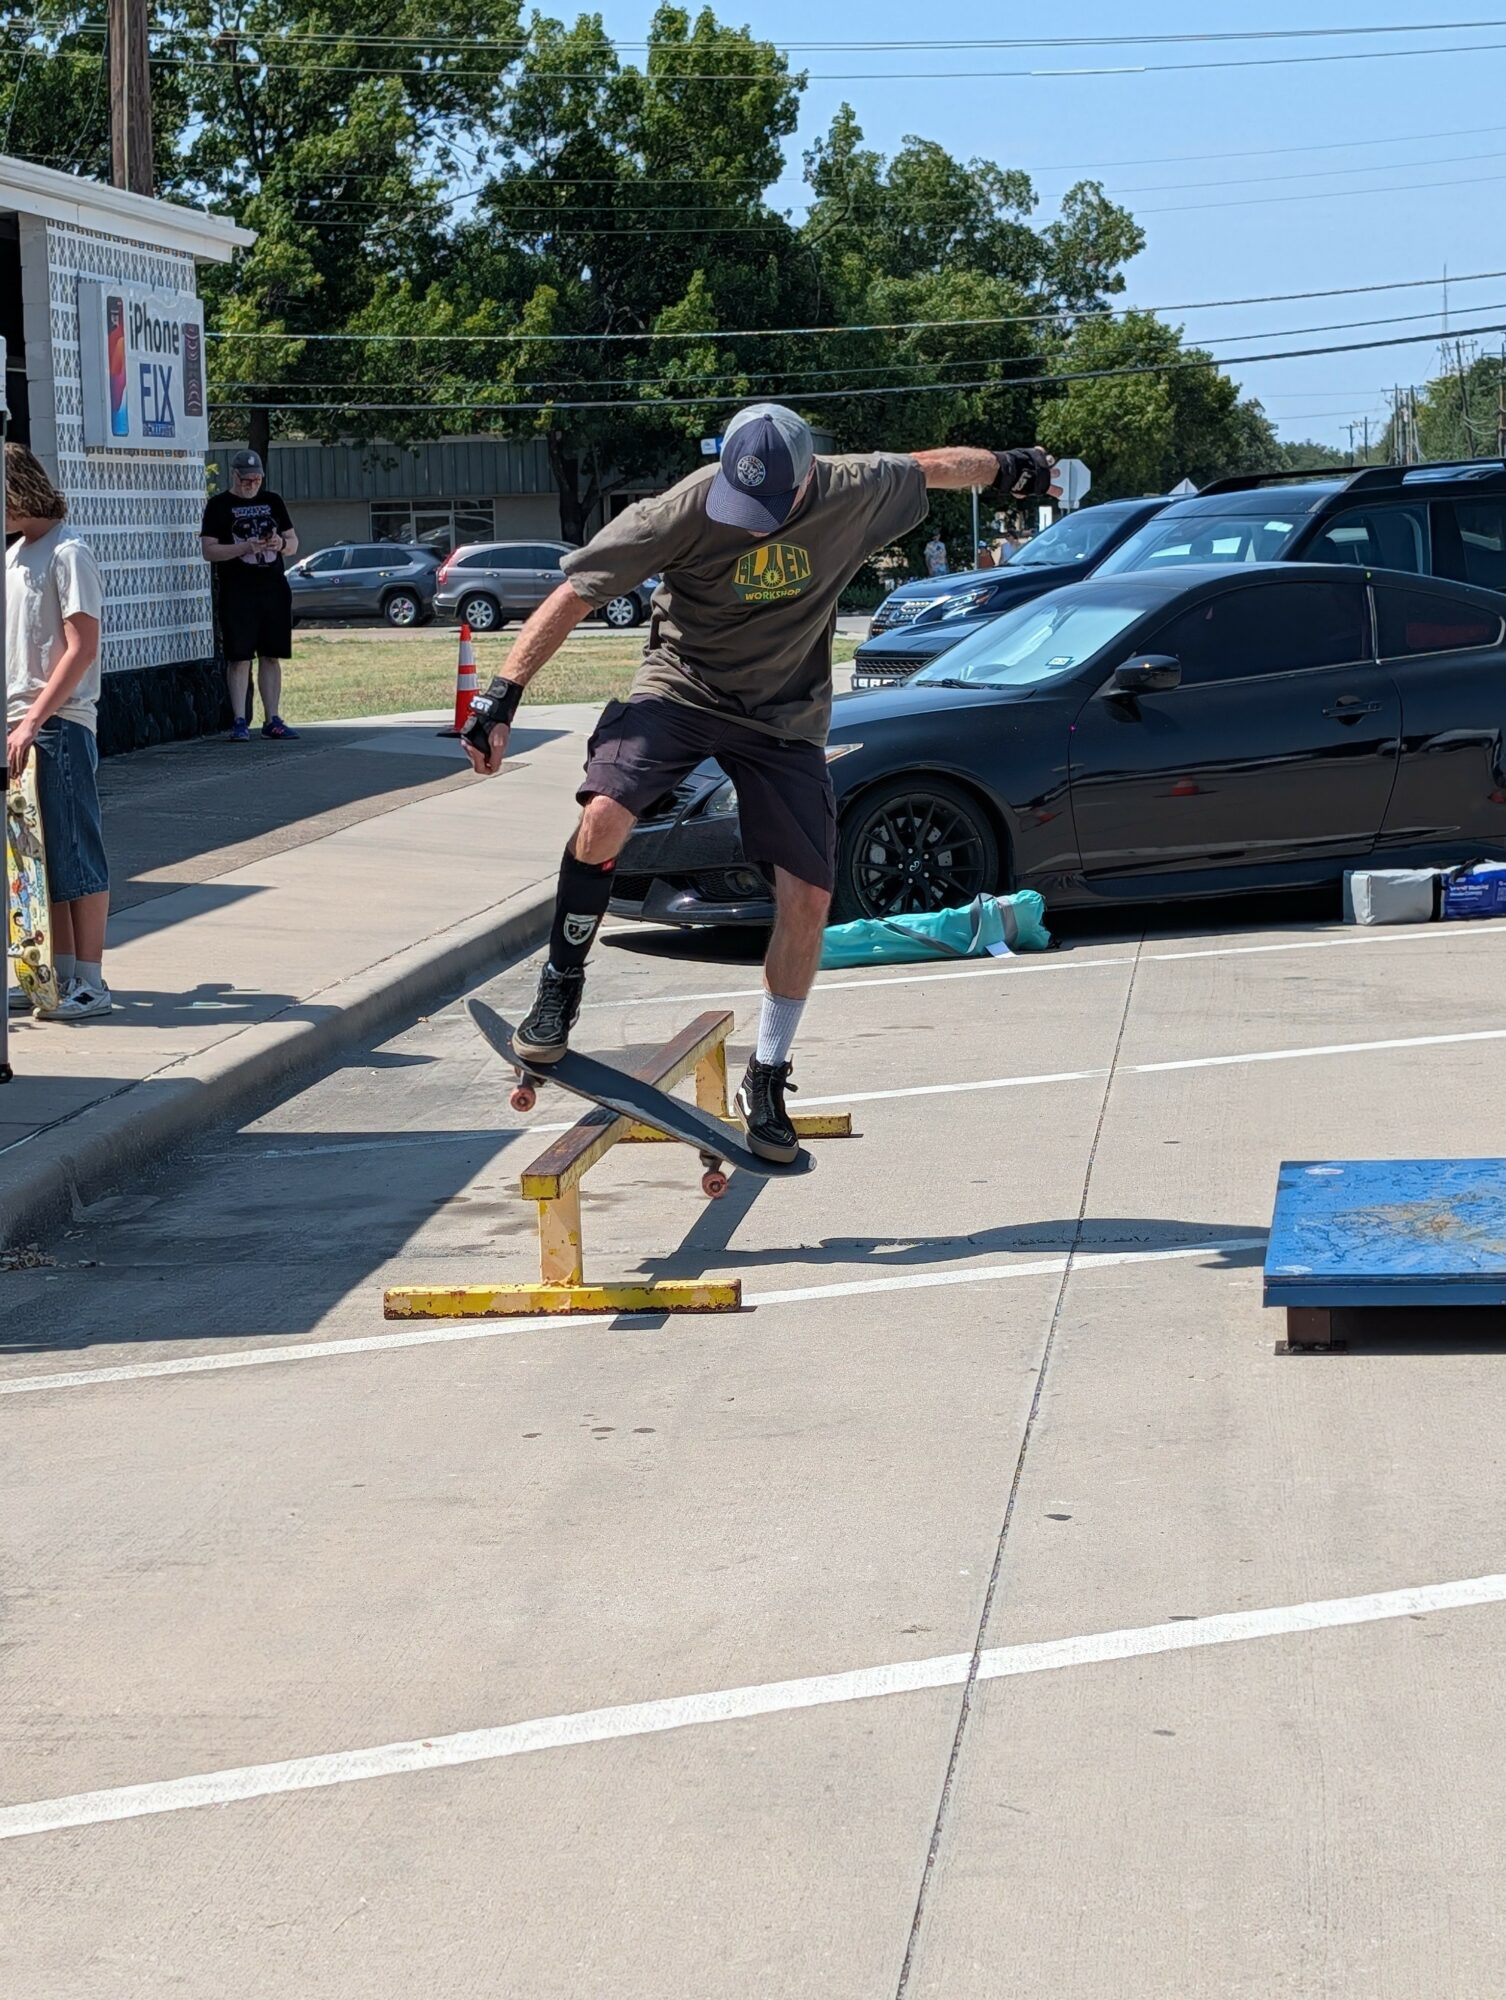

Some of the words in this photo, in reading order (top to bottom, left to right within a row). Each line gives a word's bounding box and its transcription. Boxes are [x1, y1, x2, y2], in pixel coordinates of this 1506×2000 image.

[129, 301, 180, 356] iPhone
[139, 363, 175, 424] FIX
[745, 588, 801, 600] WORKSHOP
